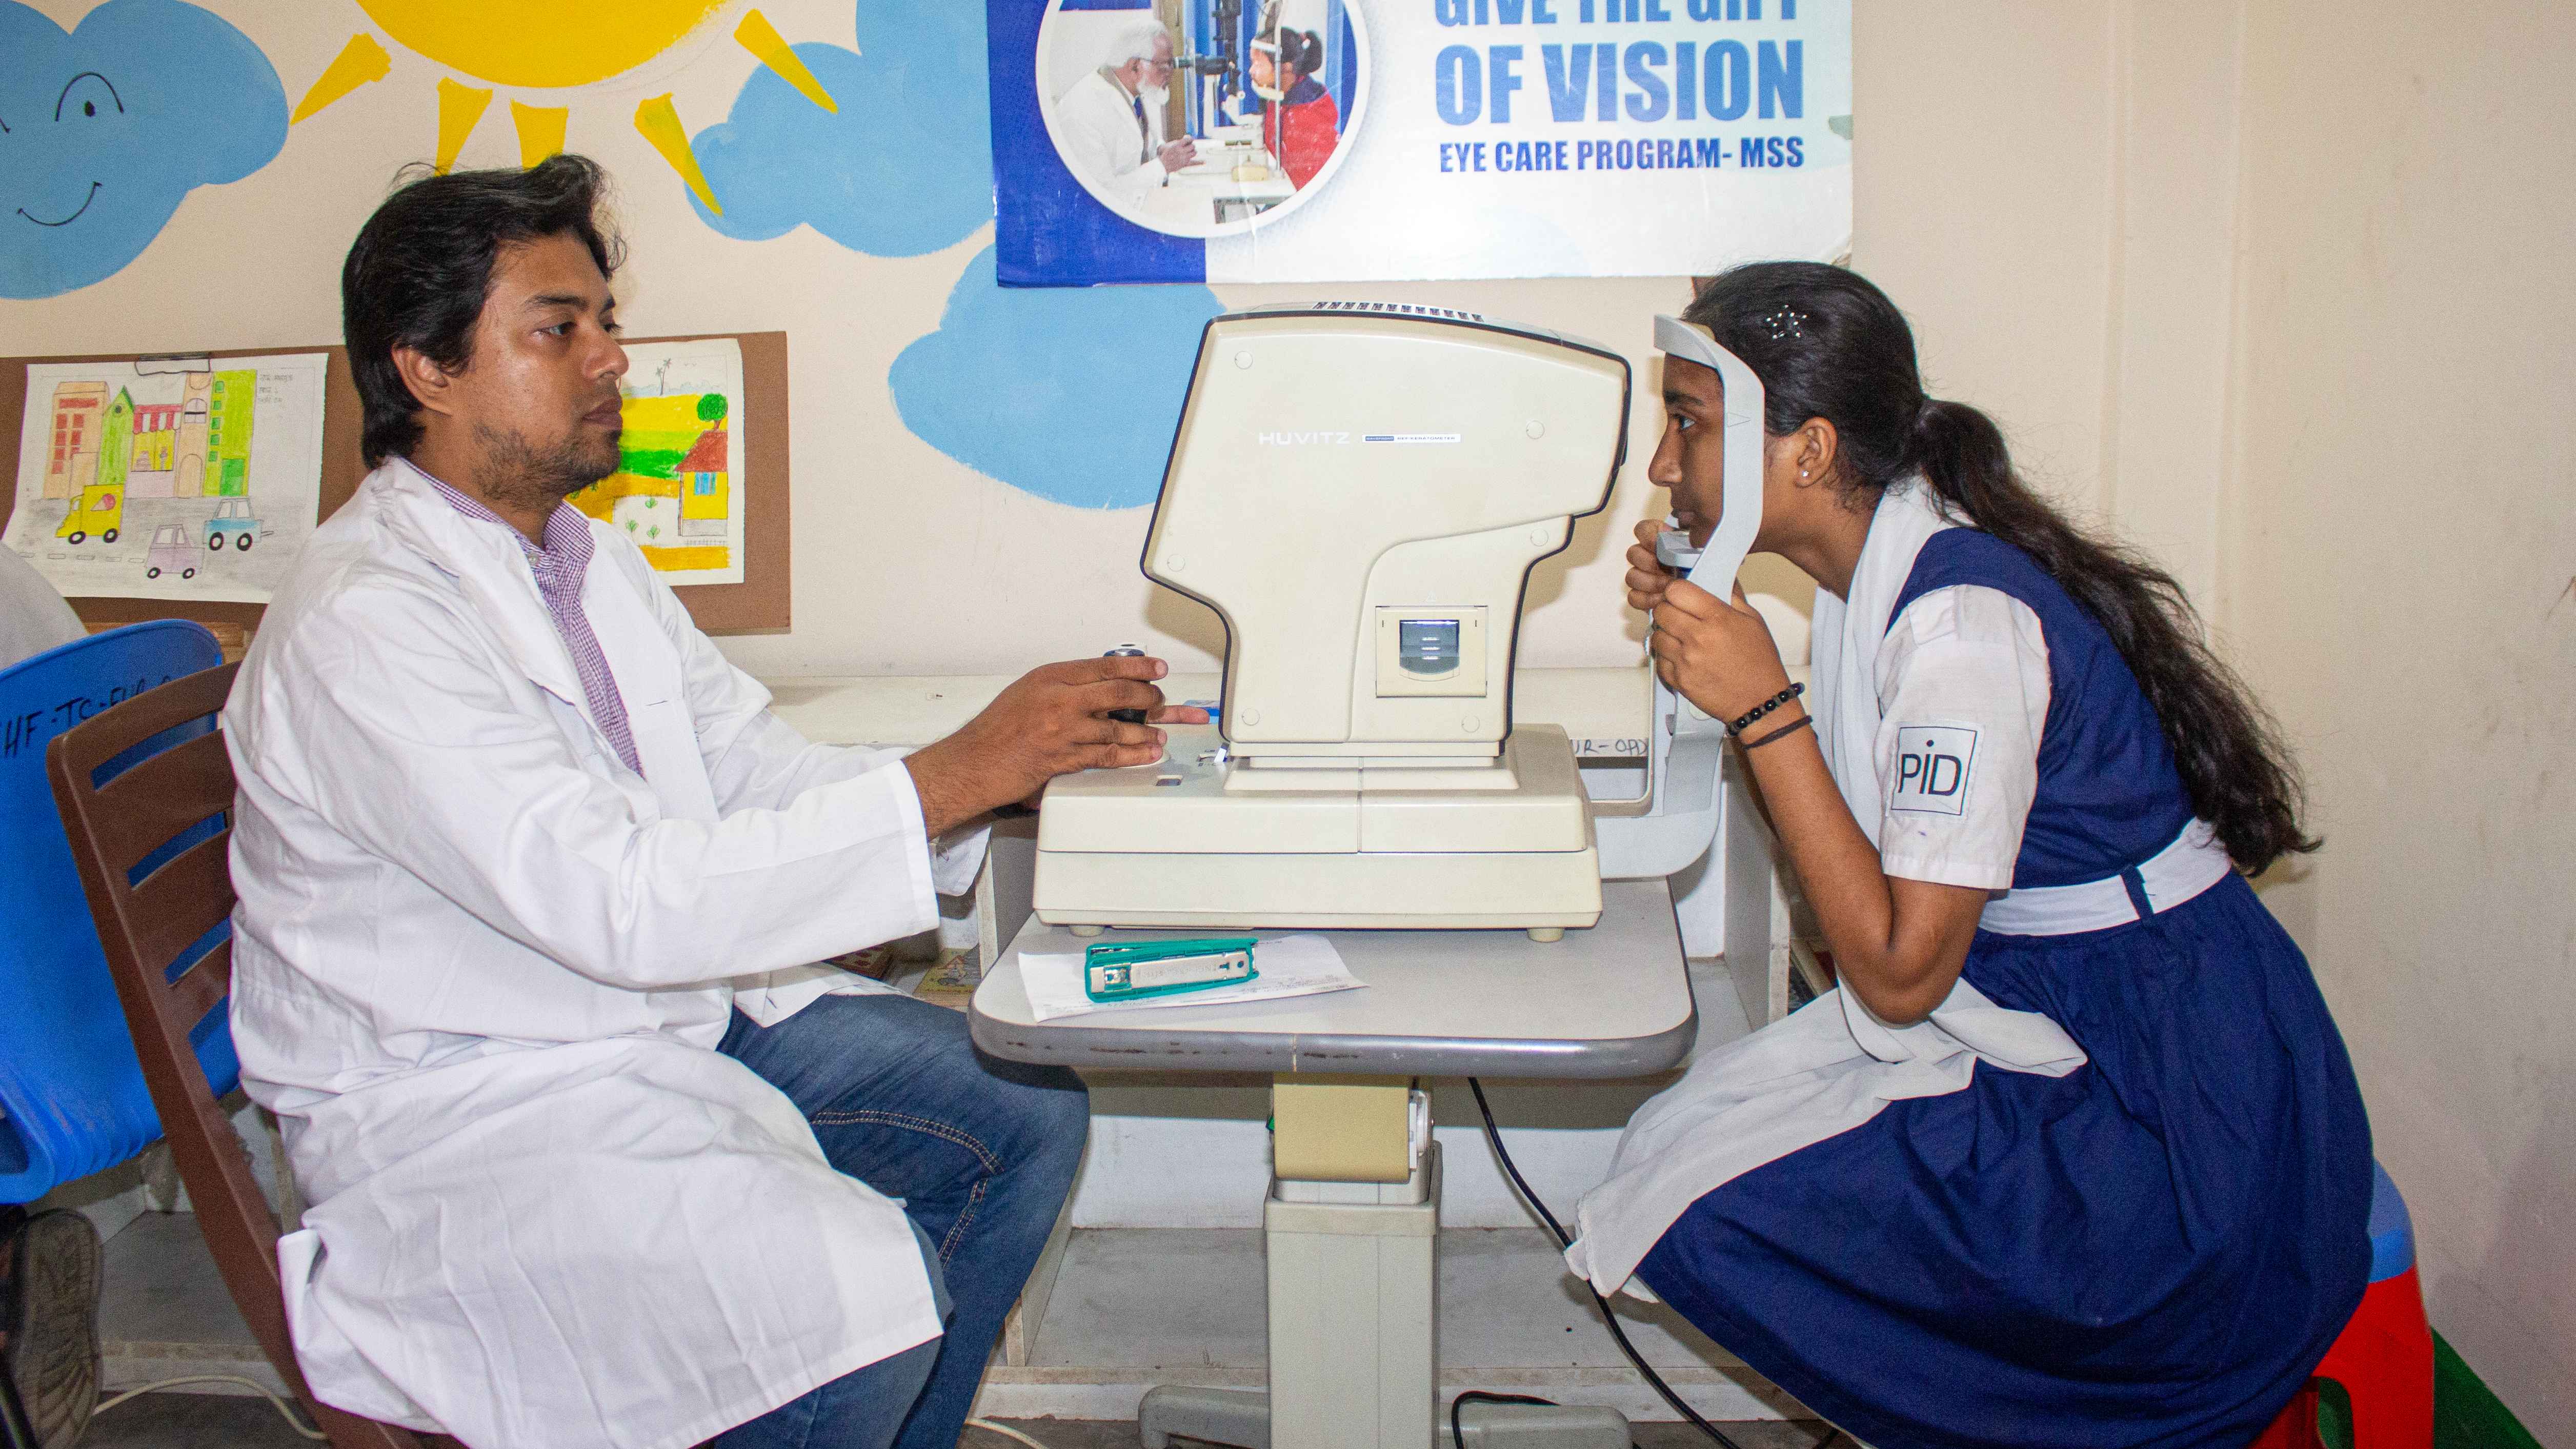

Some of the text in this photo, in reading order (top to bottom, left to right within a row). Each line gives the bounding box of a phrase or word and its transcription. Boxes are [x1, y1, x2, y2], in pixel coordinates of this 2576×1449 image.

[1435, 38, 1804, 125] OF VISION
[1440, 136, 1805, 173] EYE CARE PROGRAM- MSS
[1259, 431, 1350, 445] HUVITZ
